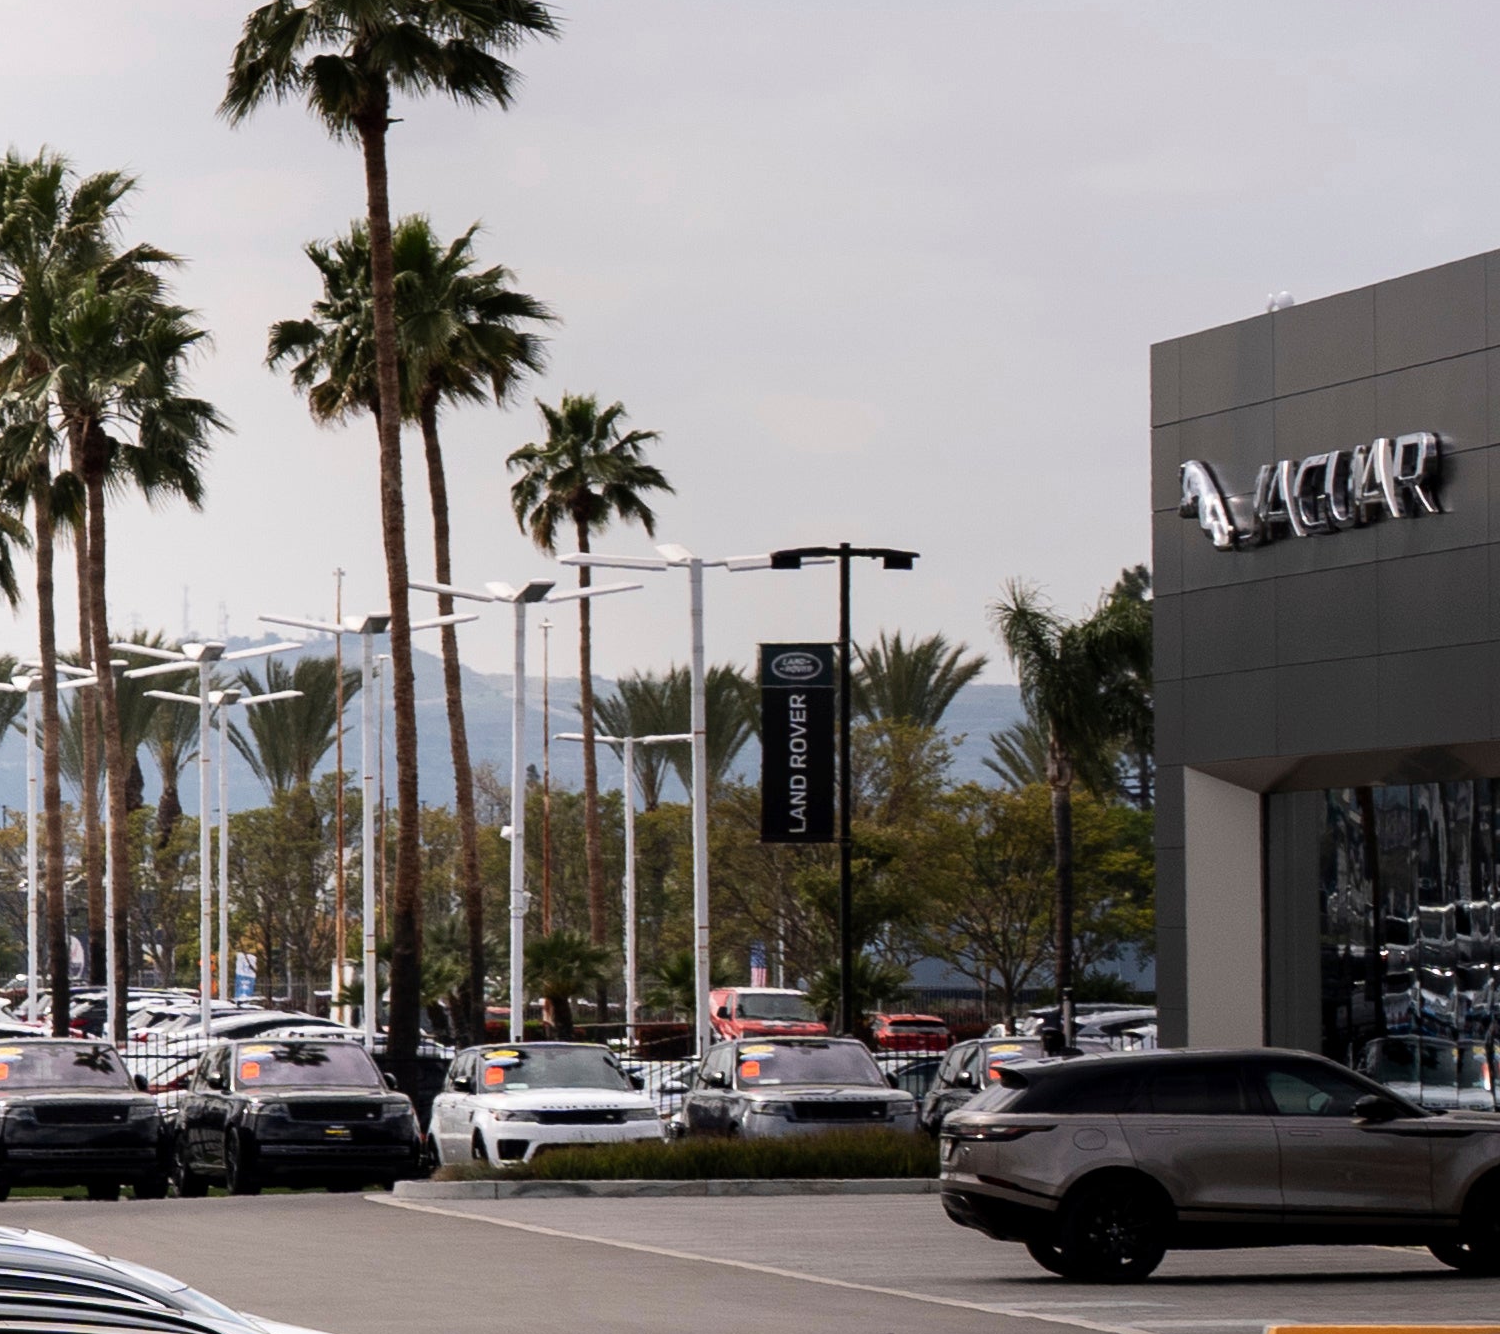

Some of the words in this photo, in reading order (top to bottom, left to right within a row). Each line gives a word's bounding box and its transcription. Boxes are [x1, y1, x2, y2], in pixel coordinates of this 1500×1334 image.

[1237, 431, 1439, 549] JAGUAR
[789, 693, 808, 768] ROVER
[789, 774, 808, 833] LAND
